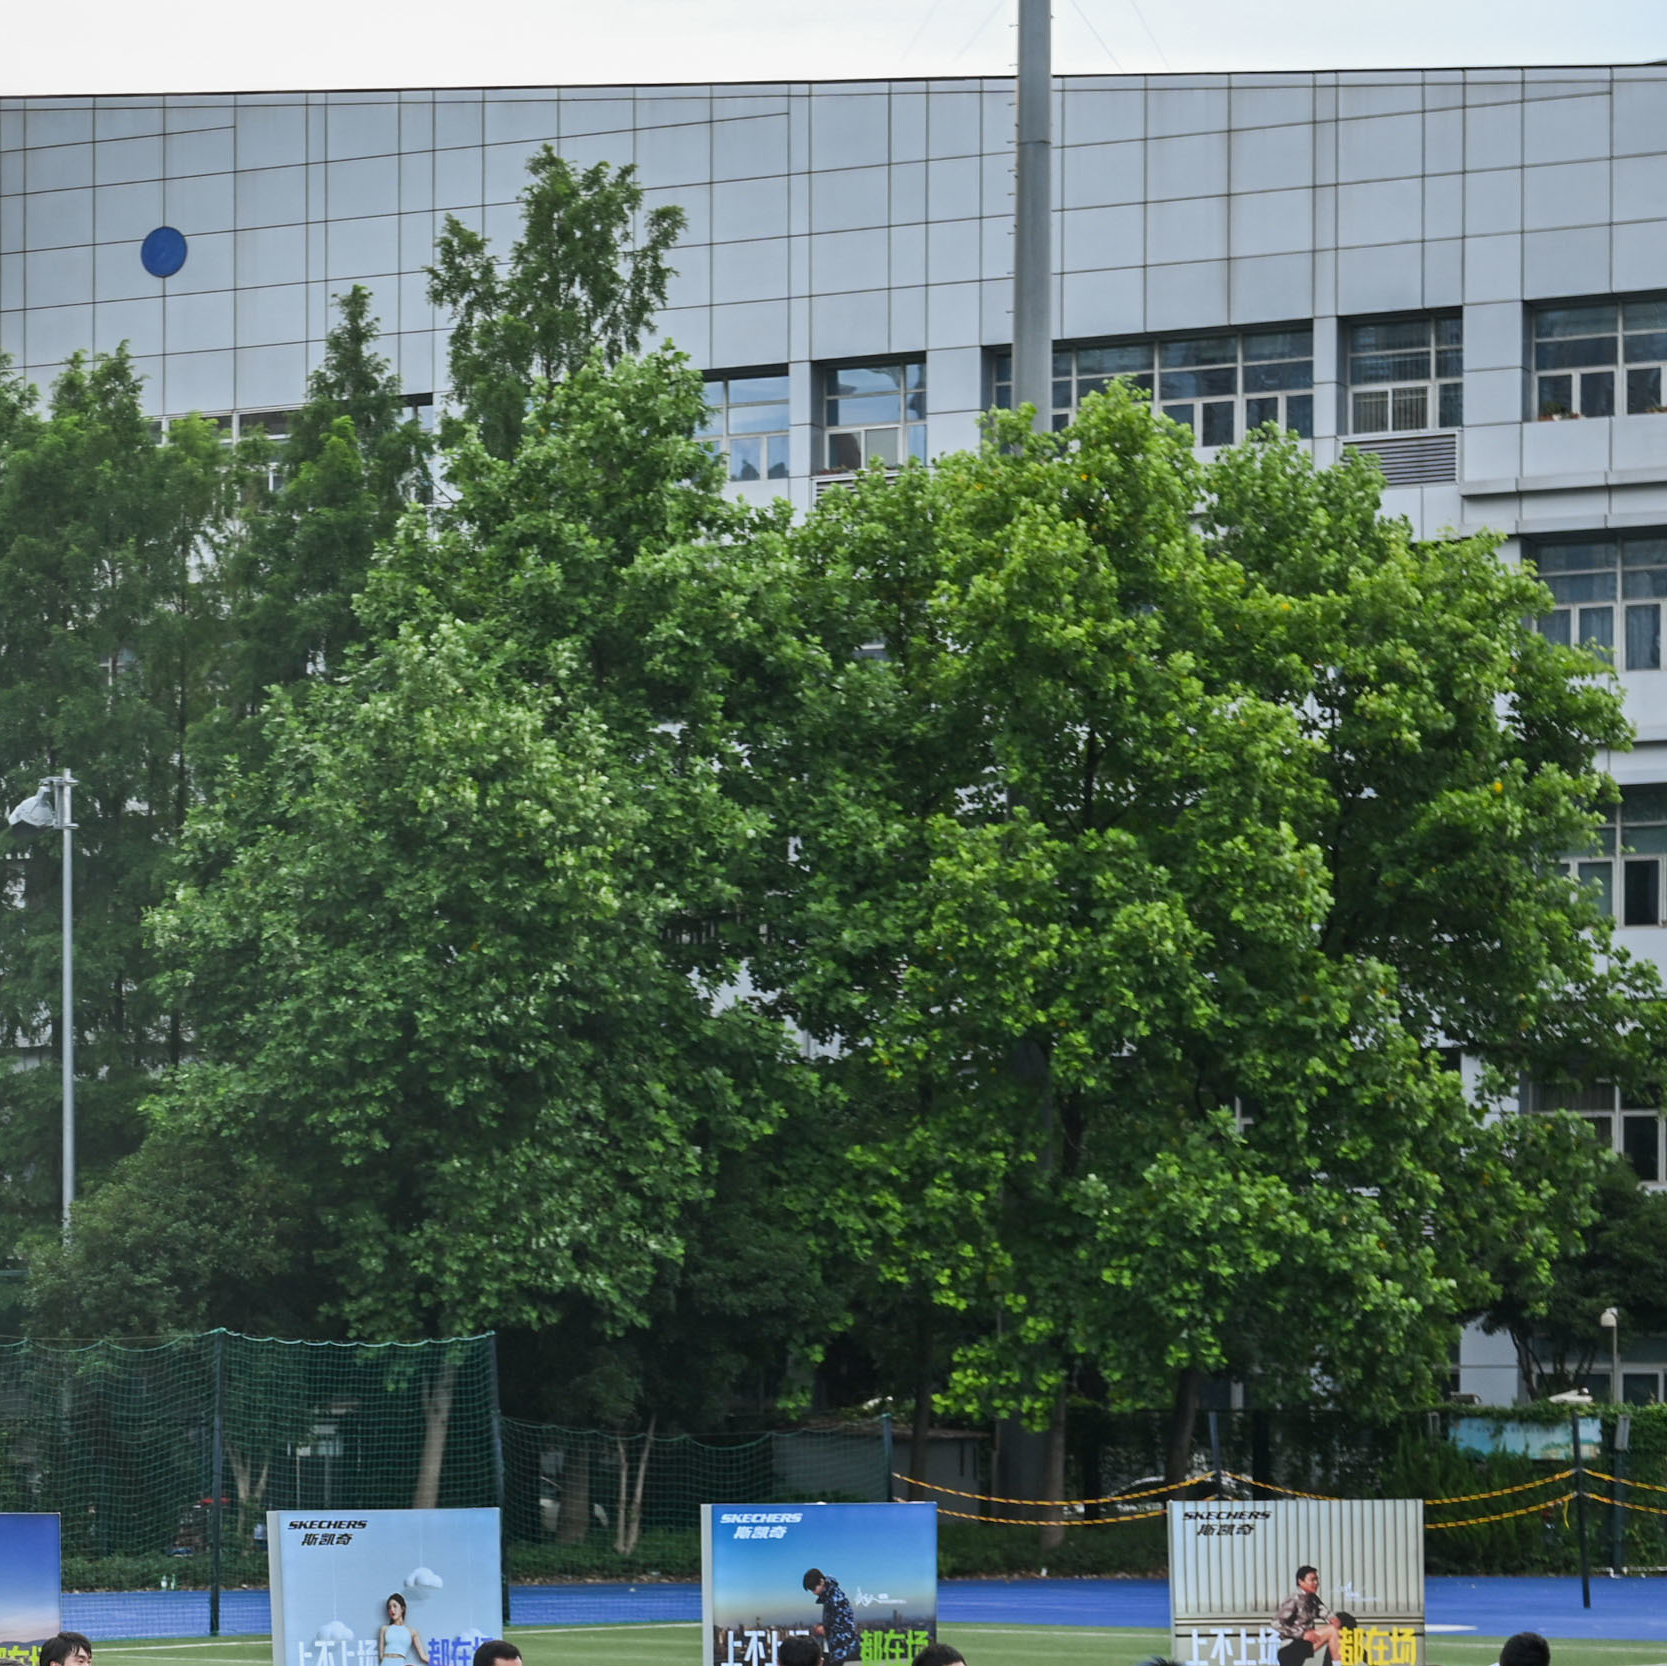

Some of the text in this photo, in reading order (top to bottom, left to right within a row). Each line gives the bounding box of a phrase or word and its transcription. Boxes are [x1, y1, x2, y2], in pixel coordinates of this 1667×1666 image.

[720, 1513, 803, 1524] SKECHERS
[1183, 1510, 1273, 1520] SKECHERS
[288, 1520, 368, 1530] SKECHERS
[301, 1533, 353, 1546] 斯凯奇
[733, 1526, 788, 1540] 斯凯奇
[1186, 1627, 1282, 1666] 上不上场
[1339, 1626, 1417, 1666] 都在场
